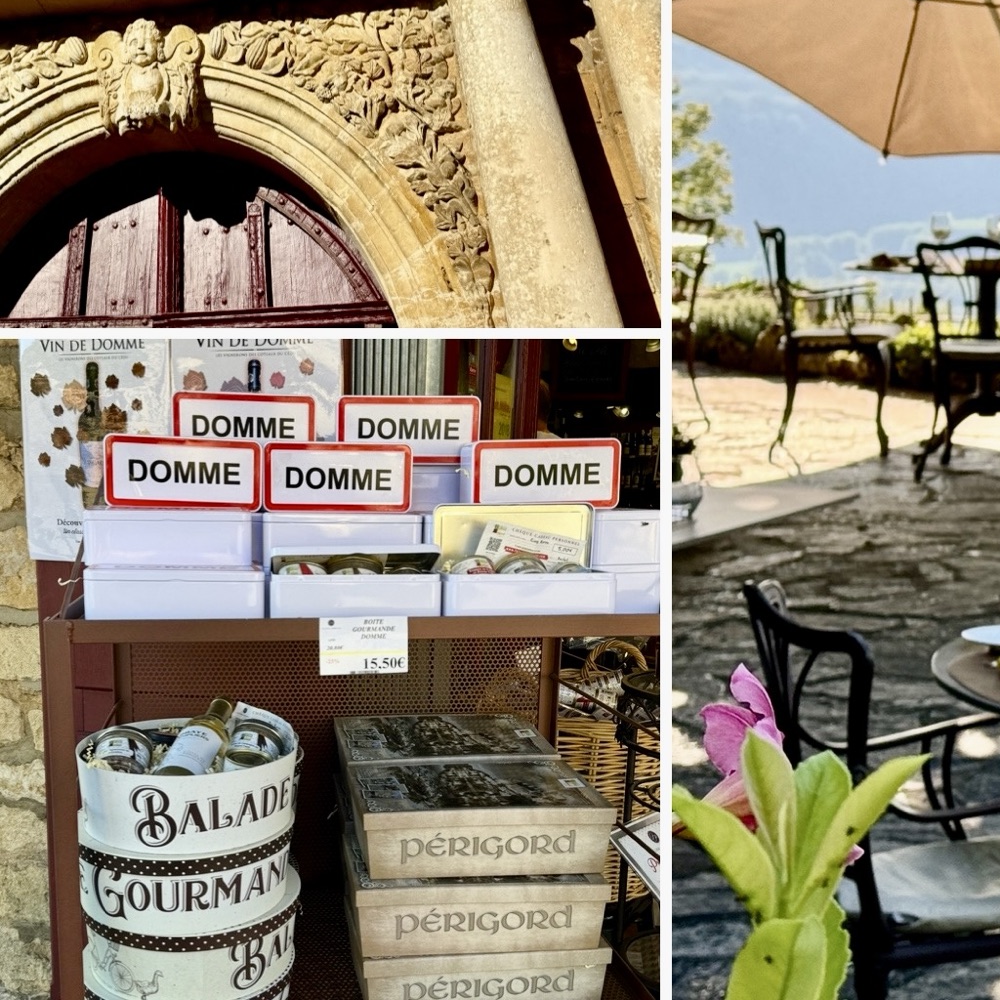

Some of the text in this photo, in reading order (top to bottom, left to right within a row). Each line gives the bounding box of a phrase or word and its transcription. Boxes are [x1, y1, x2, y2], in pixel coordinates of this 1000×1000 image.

[70, 339, 87, 352] DE
[92, 338, 146, 351] DOMME
[192, 415, 295, 439] DOMME
[357, 417, 460, 441] DOMME
[128, 458, 241, 486] DOMME
[285, 466, 393, 491] DOMME
[494, 463, 600, 487] DOMME
[363, 657, 406, 670] 15.50€
[129, 777, 291, 848] BALADE
